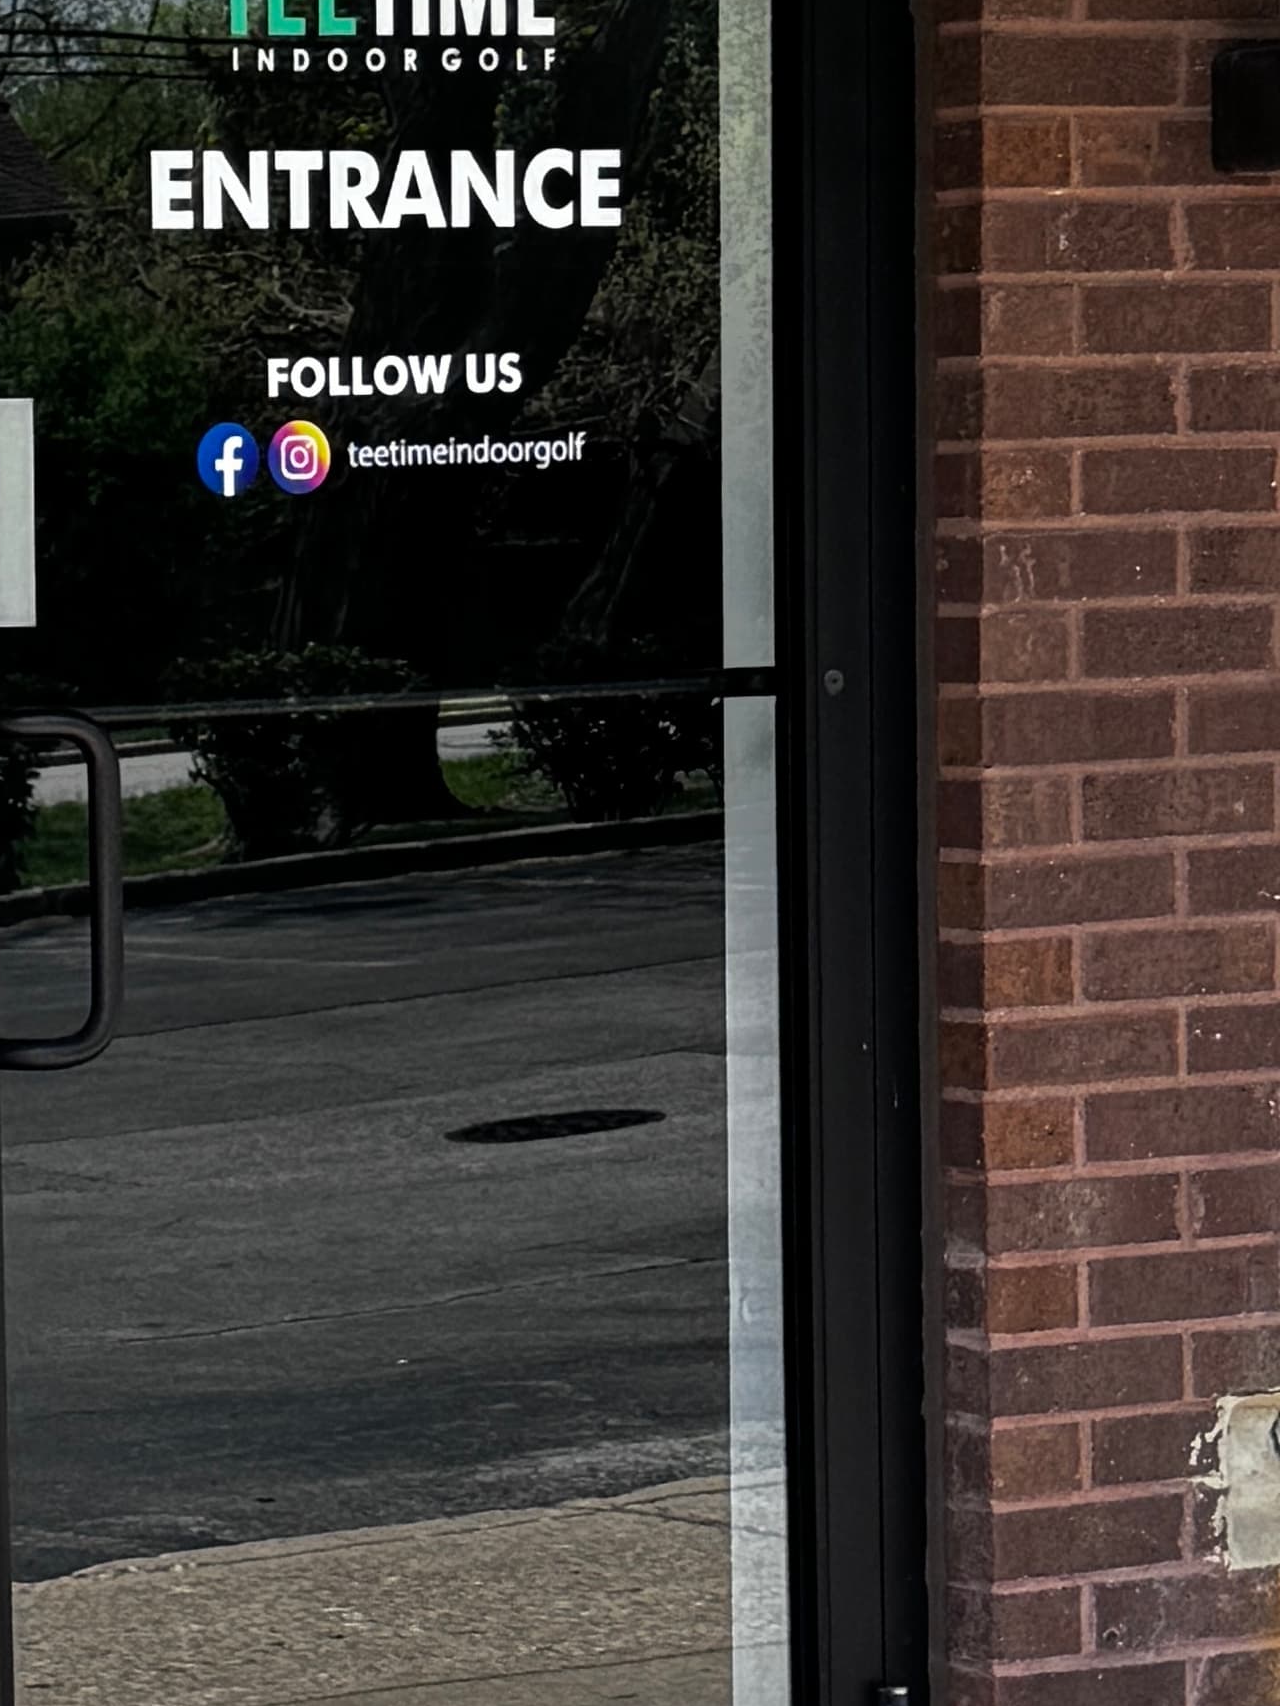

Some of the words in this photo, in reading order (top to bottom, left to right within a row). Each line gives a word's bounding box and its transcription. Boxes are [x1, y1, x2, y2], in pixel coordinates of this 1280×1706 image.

[232, 47, 418, 73] INDOOR
[441, 47, 557, 73] GOLF
[150, 148, 622, 230] ENTRANCE
[267, 354, 452, 398] FOLLOW
[465, 352, 522, 394] US
[347, 431, 586, 469] teetimeindoorgolf
